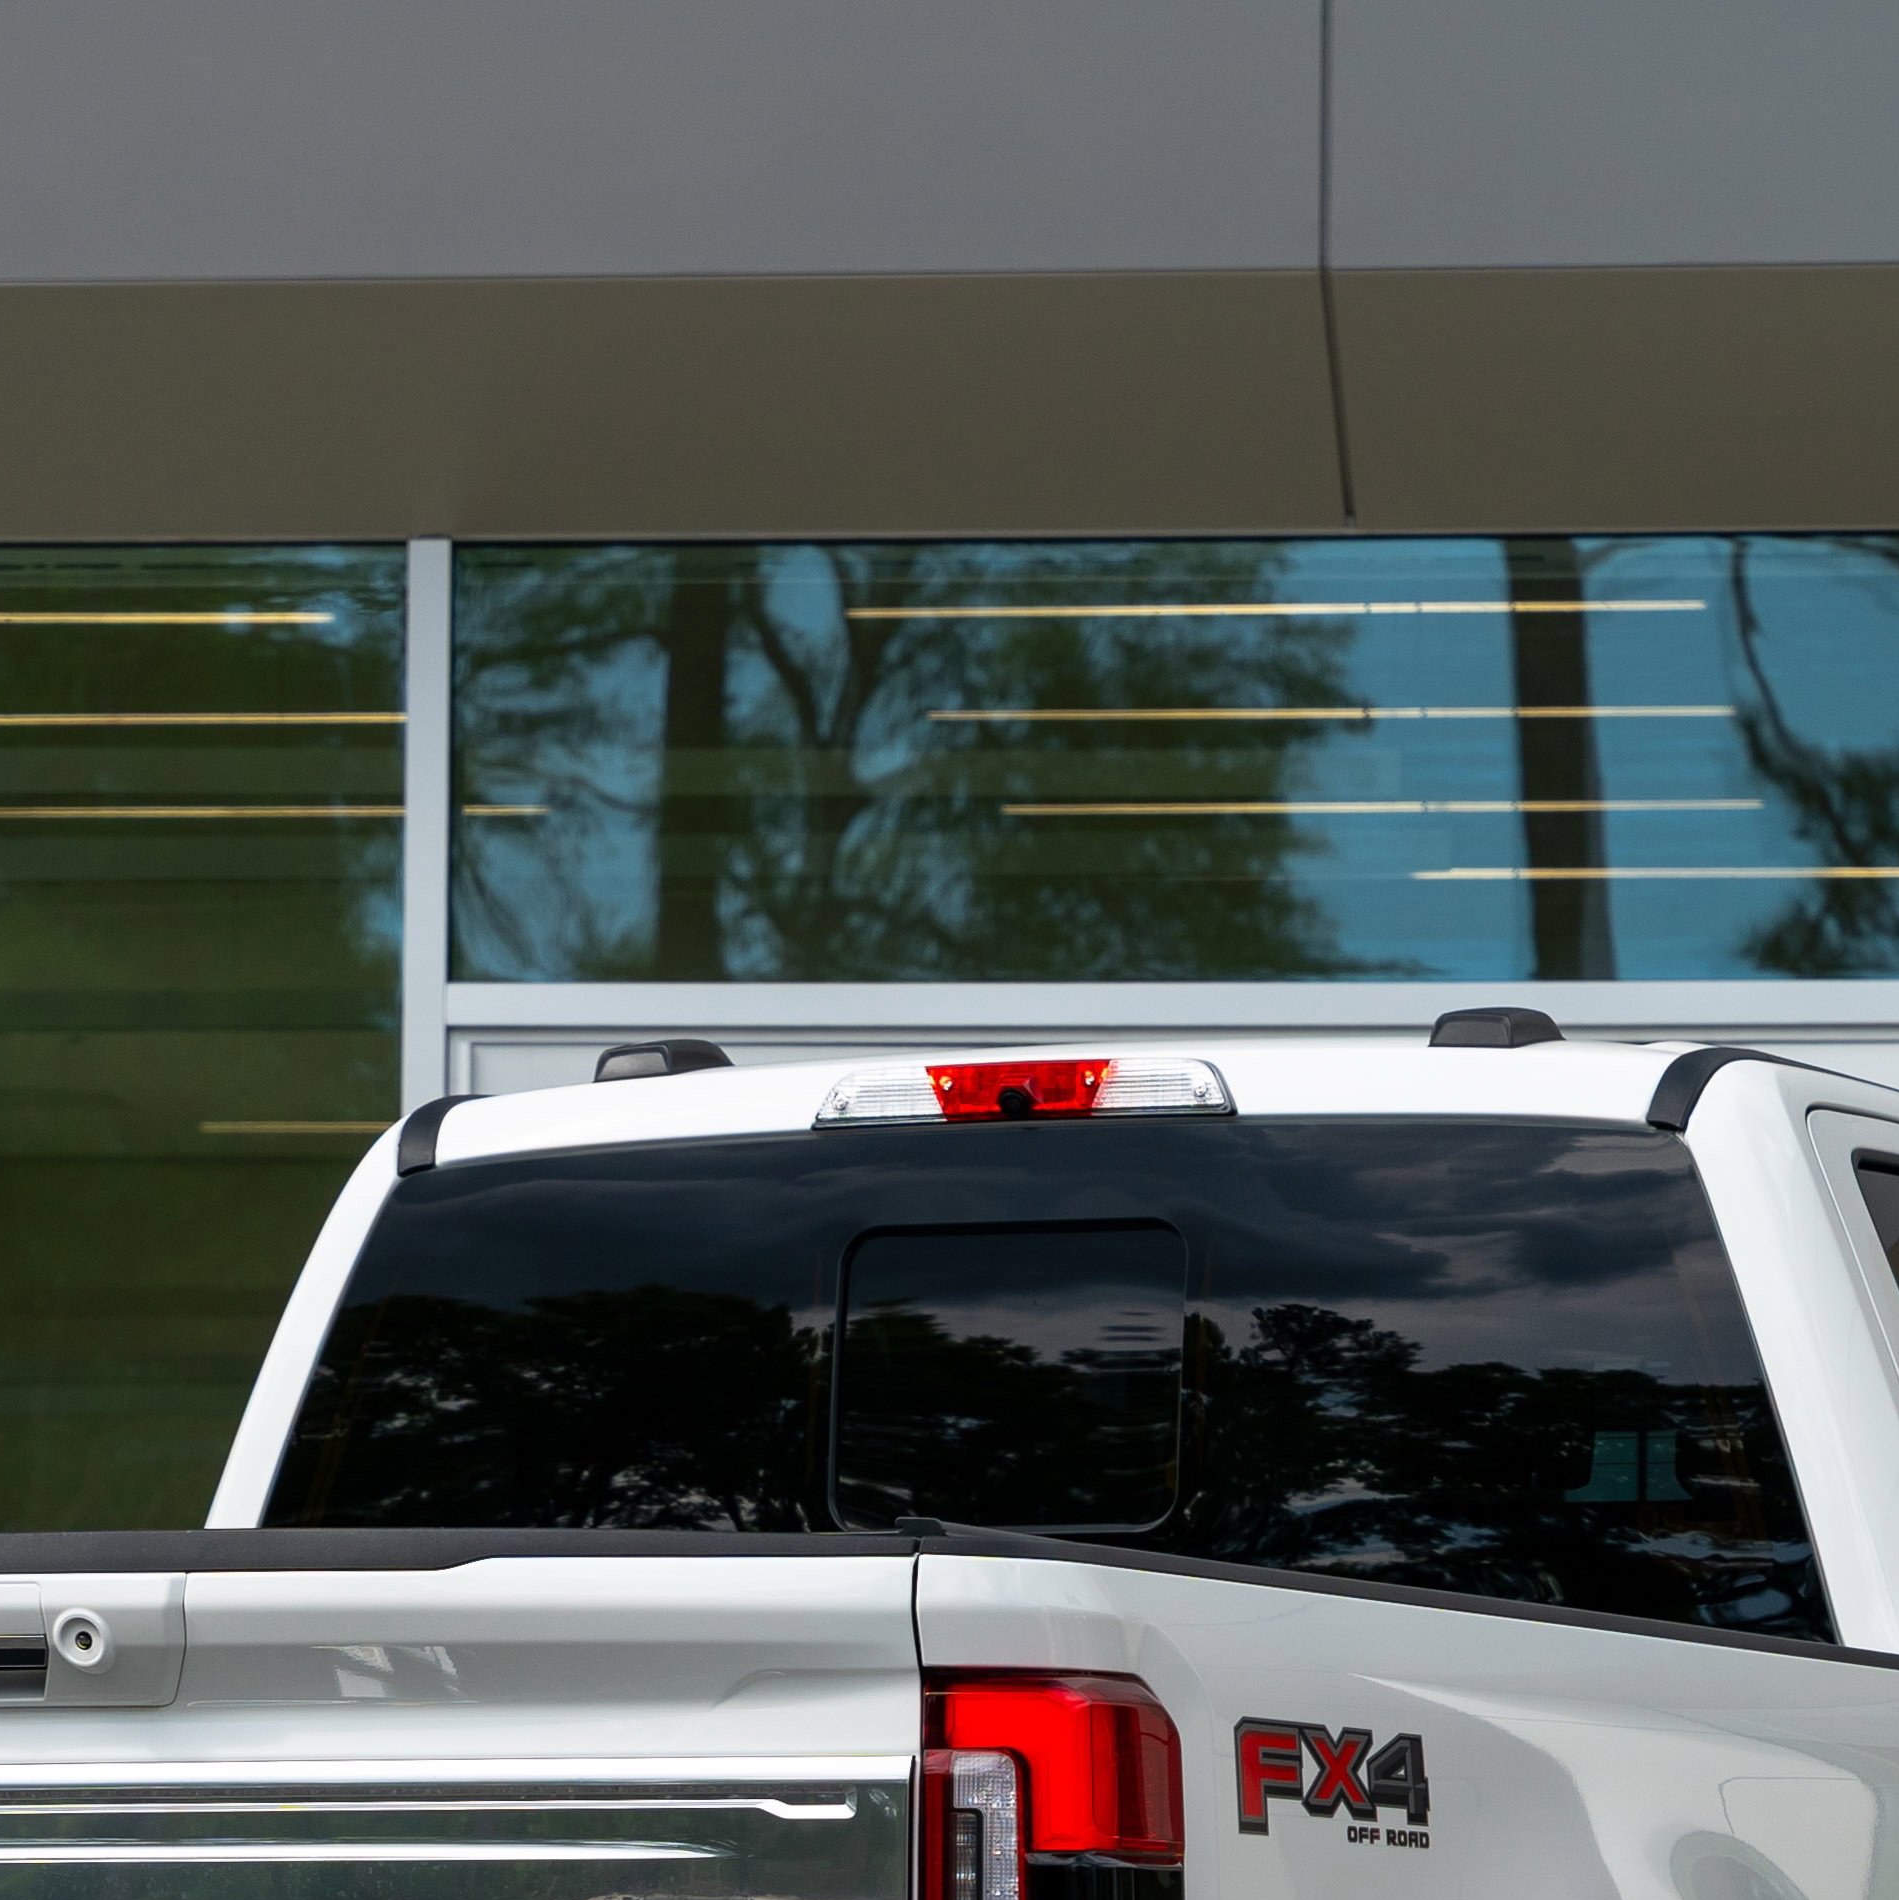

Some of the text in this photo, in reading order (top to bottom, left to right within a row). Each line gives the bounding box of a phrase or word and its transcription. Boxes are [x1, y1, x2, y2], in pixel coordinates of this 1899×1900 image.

[1234, 1716, 1430, 1836] FX4
[1347, 1825, 1430, 1849] OFF ROAD
